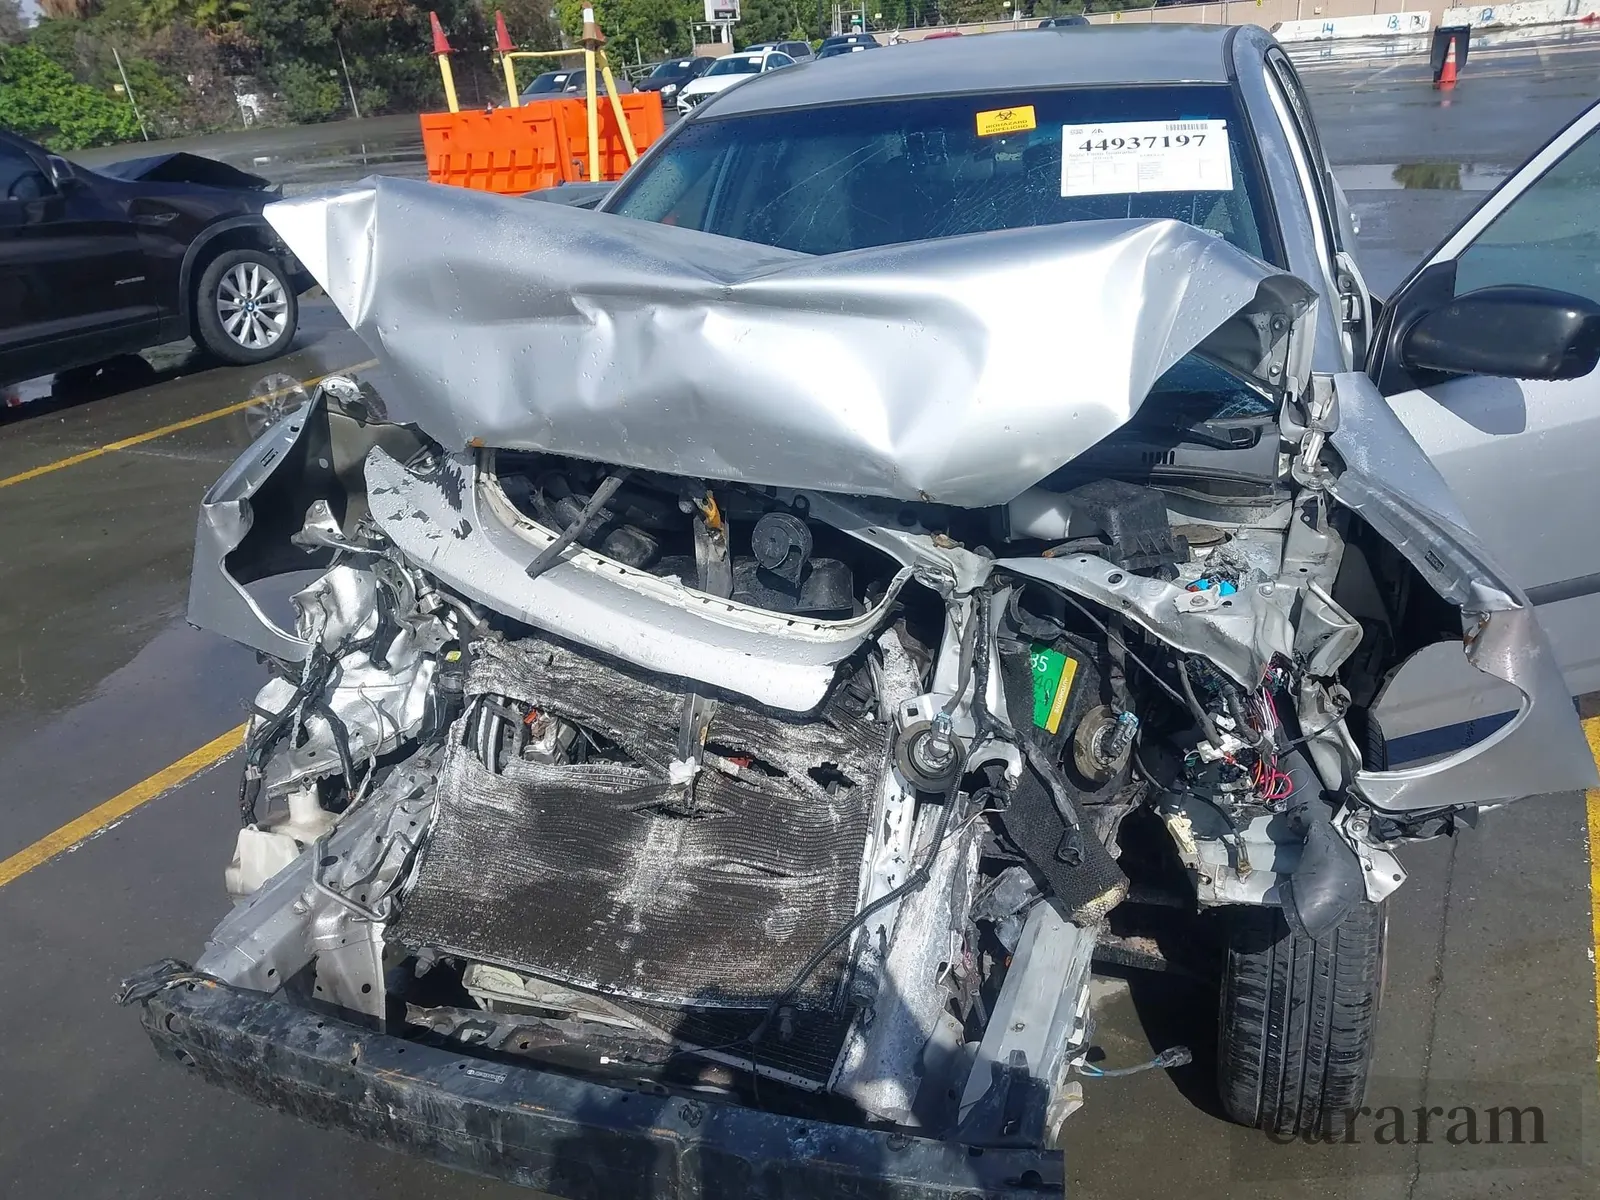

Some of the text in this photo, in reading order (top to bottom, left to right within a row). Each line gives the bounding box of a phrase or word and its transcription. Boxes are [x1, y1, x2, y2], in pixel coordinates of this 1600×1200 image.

[1322, 22, 1334, 34] 14
[985, 120, 1028, 129] BIOHAZARD
[1079, 134, 1206, 152] 44937197
[1054, 677, 1069, 713] AUTOMOTIVE
